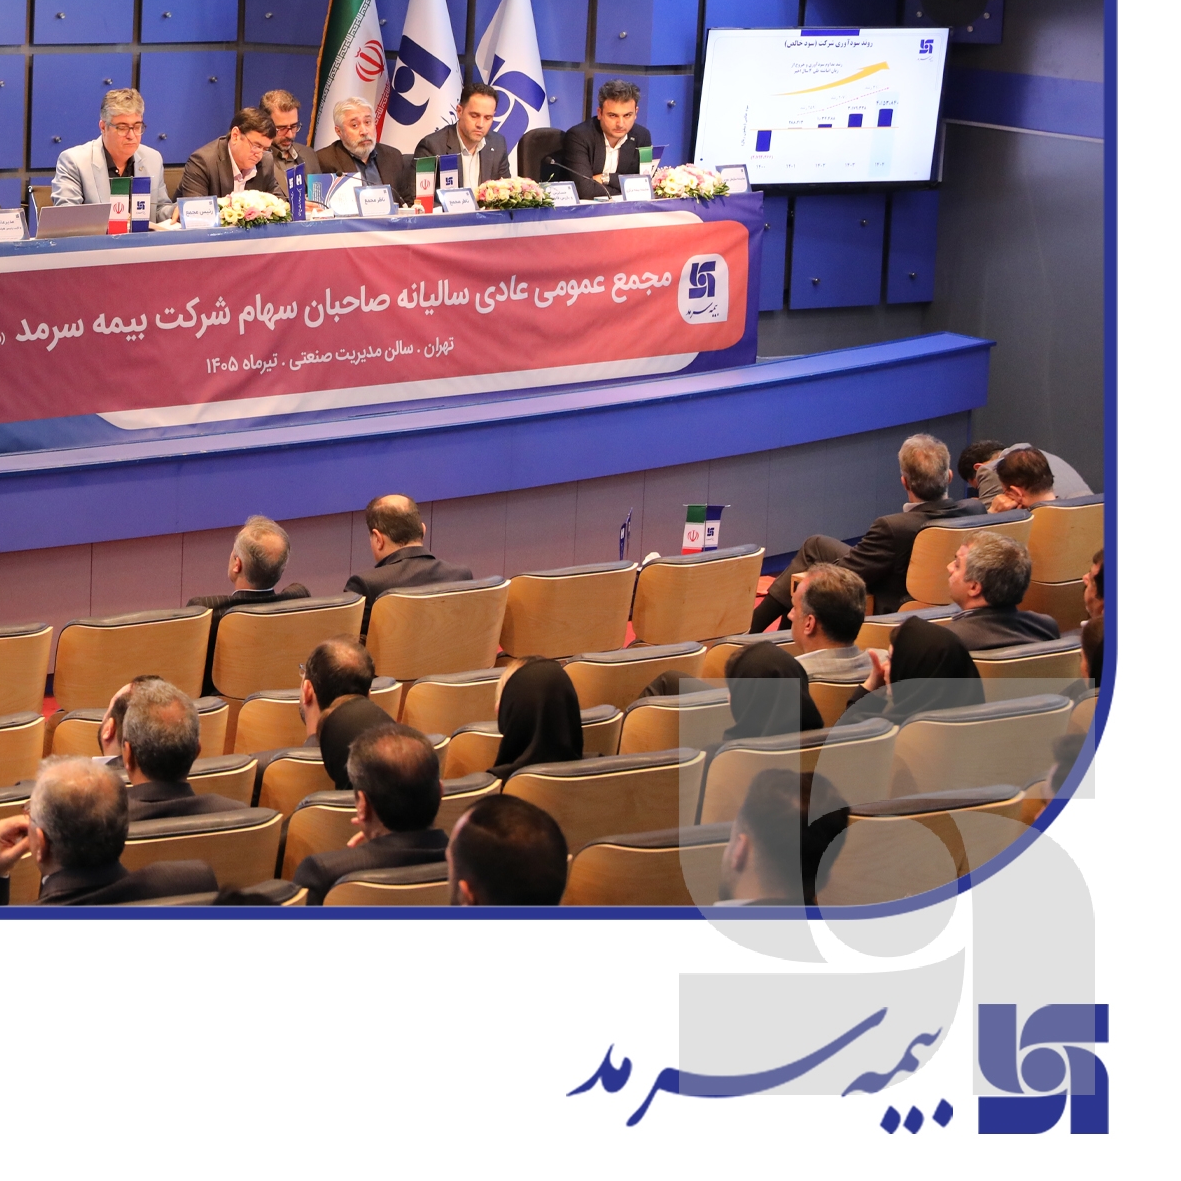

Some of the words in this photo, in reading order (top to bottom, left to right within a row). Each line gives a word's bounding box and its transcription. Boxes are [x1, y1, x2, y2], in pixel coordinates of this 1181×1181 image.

[397, 279, 469, 315] سالیانه
[475, 274, 528, 314] عادی
[533, 274, 606, 308] عمومی
[611, 269, 672, 303] مجمع
[155, 295, 231, 339] شرکت
[238, 293, 298, 335] سهام
[304, 285, 390, 328] صاحبان
[15, 318, 85, 352] سرمد
[92, 310, 148, 342] بیمه
[242, 352, 278, 375] تیرماه
[289, 350, 333, 371] صنعتی
[335, 345, 382, 366] مدیریت
[384, 340, 414, 363] سالن
[423, 336, 454, 358] تهران
[206, 356, 239, 374] ۱۴۰۵
